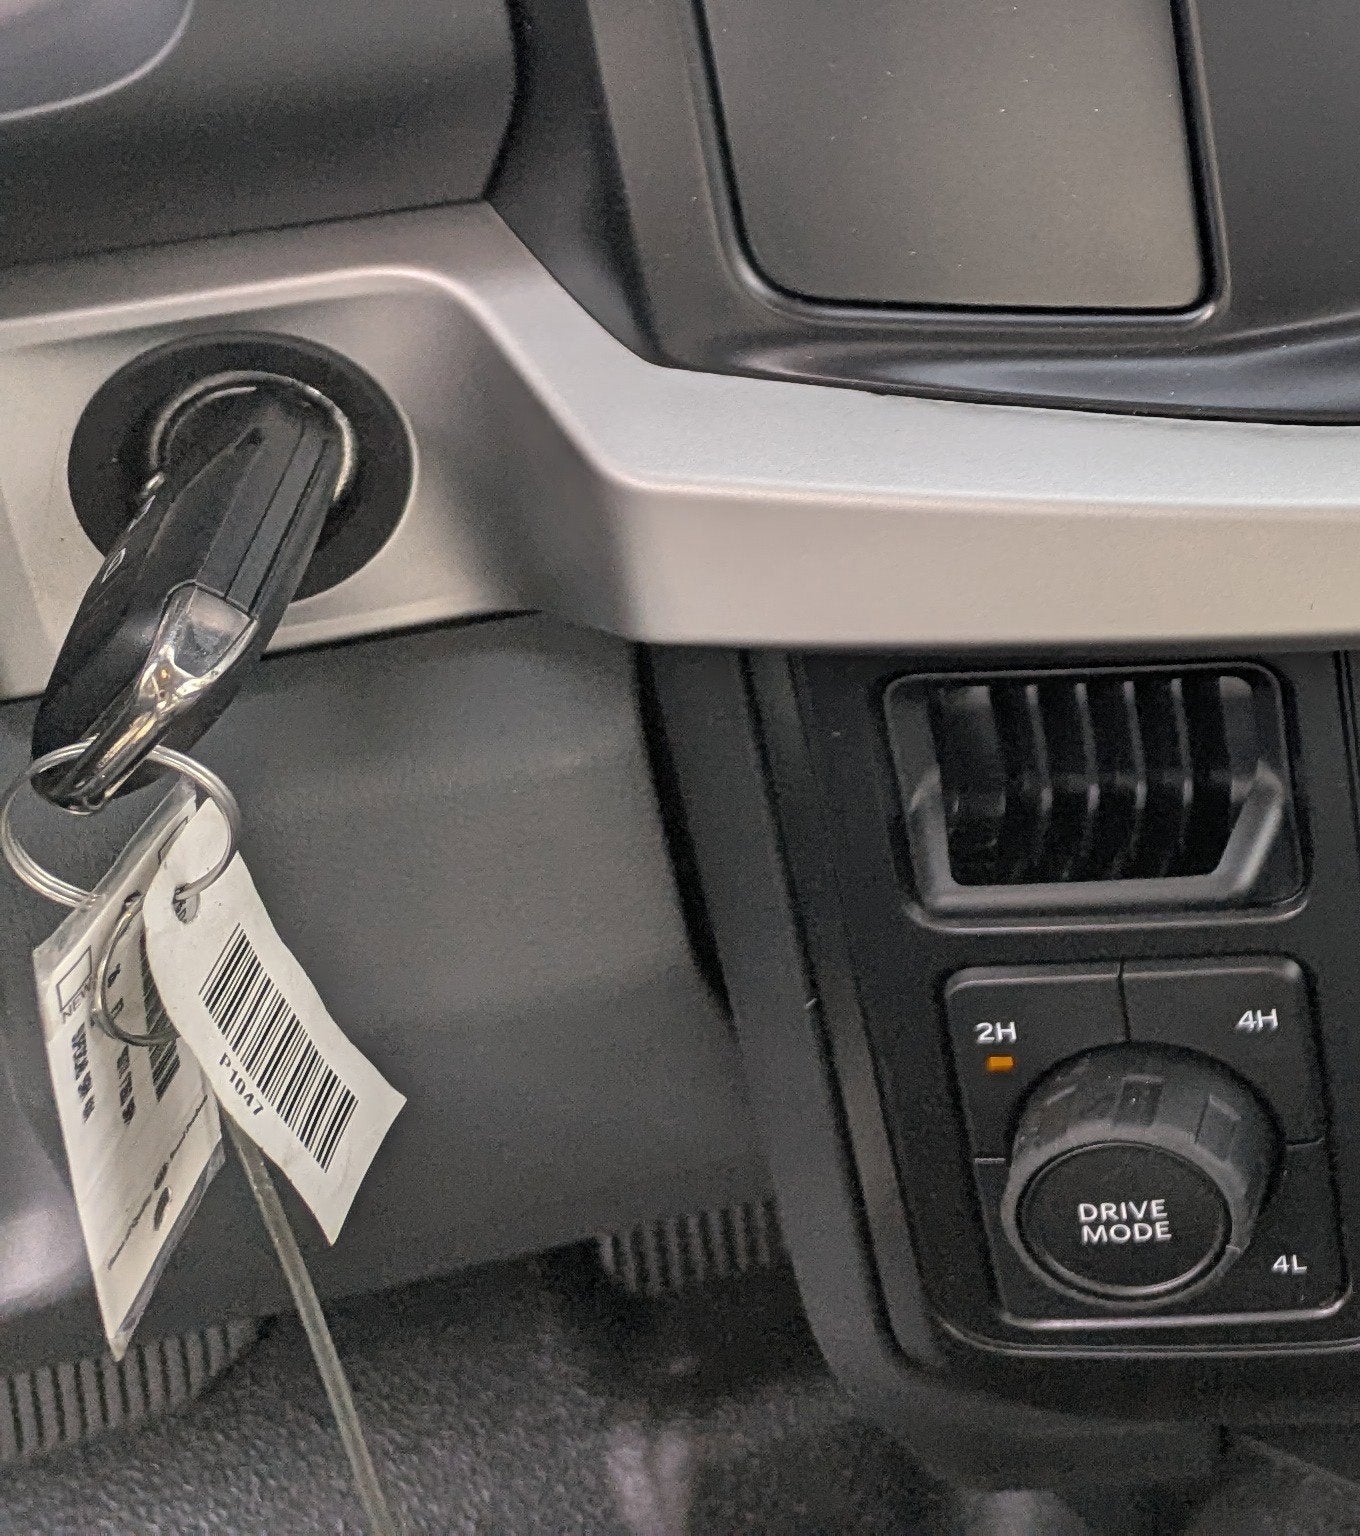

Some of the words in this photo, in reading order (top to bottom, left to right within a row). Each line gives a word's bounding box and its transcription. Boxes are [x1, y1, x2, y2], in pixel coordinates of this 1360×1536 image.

[1234, 1007, 1280, 1031] 4H
[975, 1020, 1018, 1044] 2H
[1077, 1198, 1170, 1223] DRIVE
[1081, 1220, 1173, 1246] MODE
[1271, 1253, 1308, 1276] 4L
